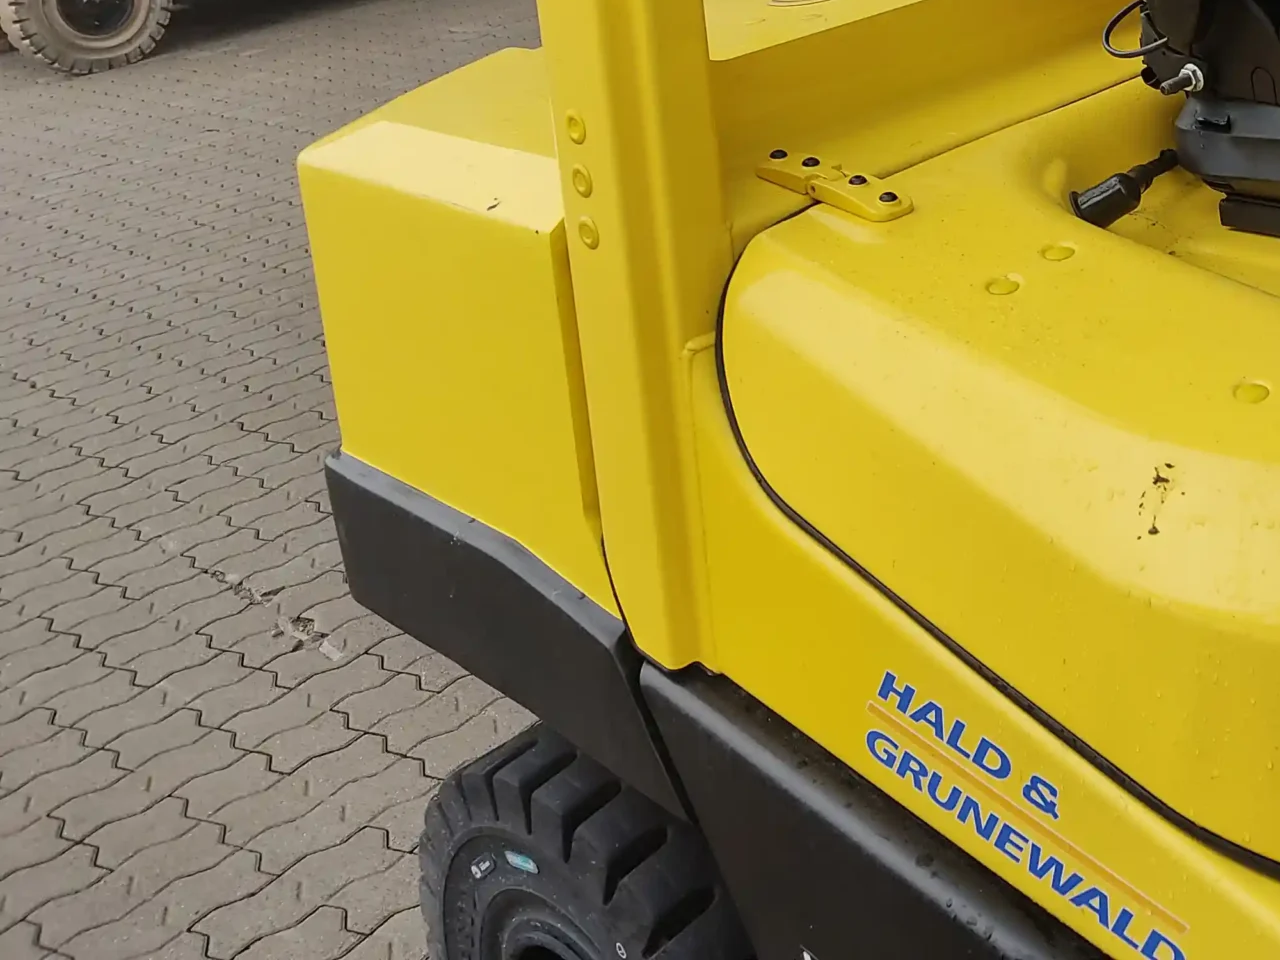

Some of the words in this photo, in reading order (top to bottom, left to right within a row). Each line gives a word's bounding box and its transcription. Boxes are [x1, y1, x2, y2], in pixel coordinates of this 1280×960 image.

[876, 669, 1012, 780] HALD
[1021, 773, 1060, 820] &
[865, 729, 1187, 960] GRUNEWALD
